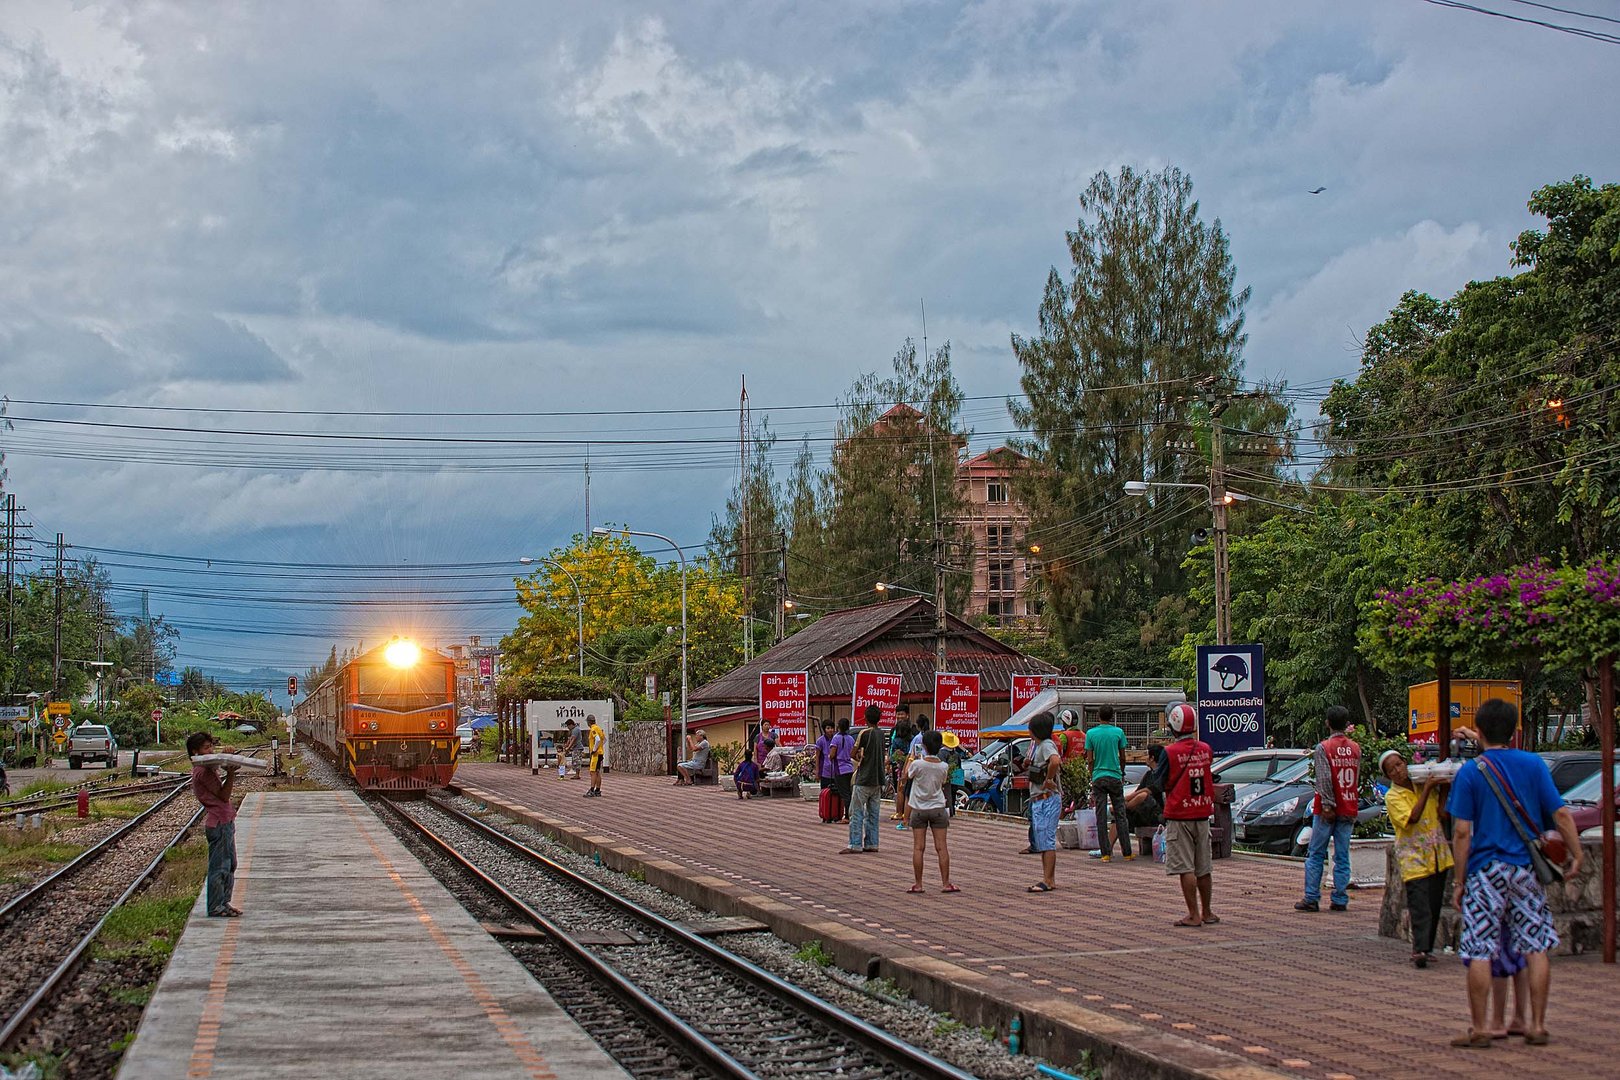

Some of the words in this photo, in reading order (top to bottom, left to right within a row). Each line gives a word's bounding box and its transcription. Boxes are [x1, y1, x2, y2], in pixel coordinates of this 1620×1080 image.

[876, 676, 899, 685] อยาก
[778, 687, 805, 697] อย่าง...
[765, 700, 805, 709] อดอยาก
[940, 696, 967, 711] เบื่อ!!!
[1199, 696, 1263, 708] สวมหมวกนิรภัย
[555, 705, 585, 718] หัวหิน
[1205, 712, 1260, 733] 100%
[1336, 746, 1352, 756] 026
[1188, 768, 1205, 777] 026
[1337, 767, 1355, 788] 19
[1194, 778, 1201, 793] 3
